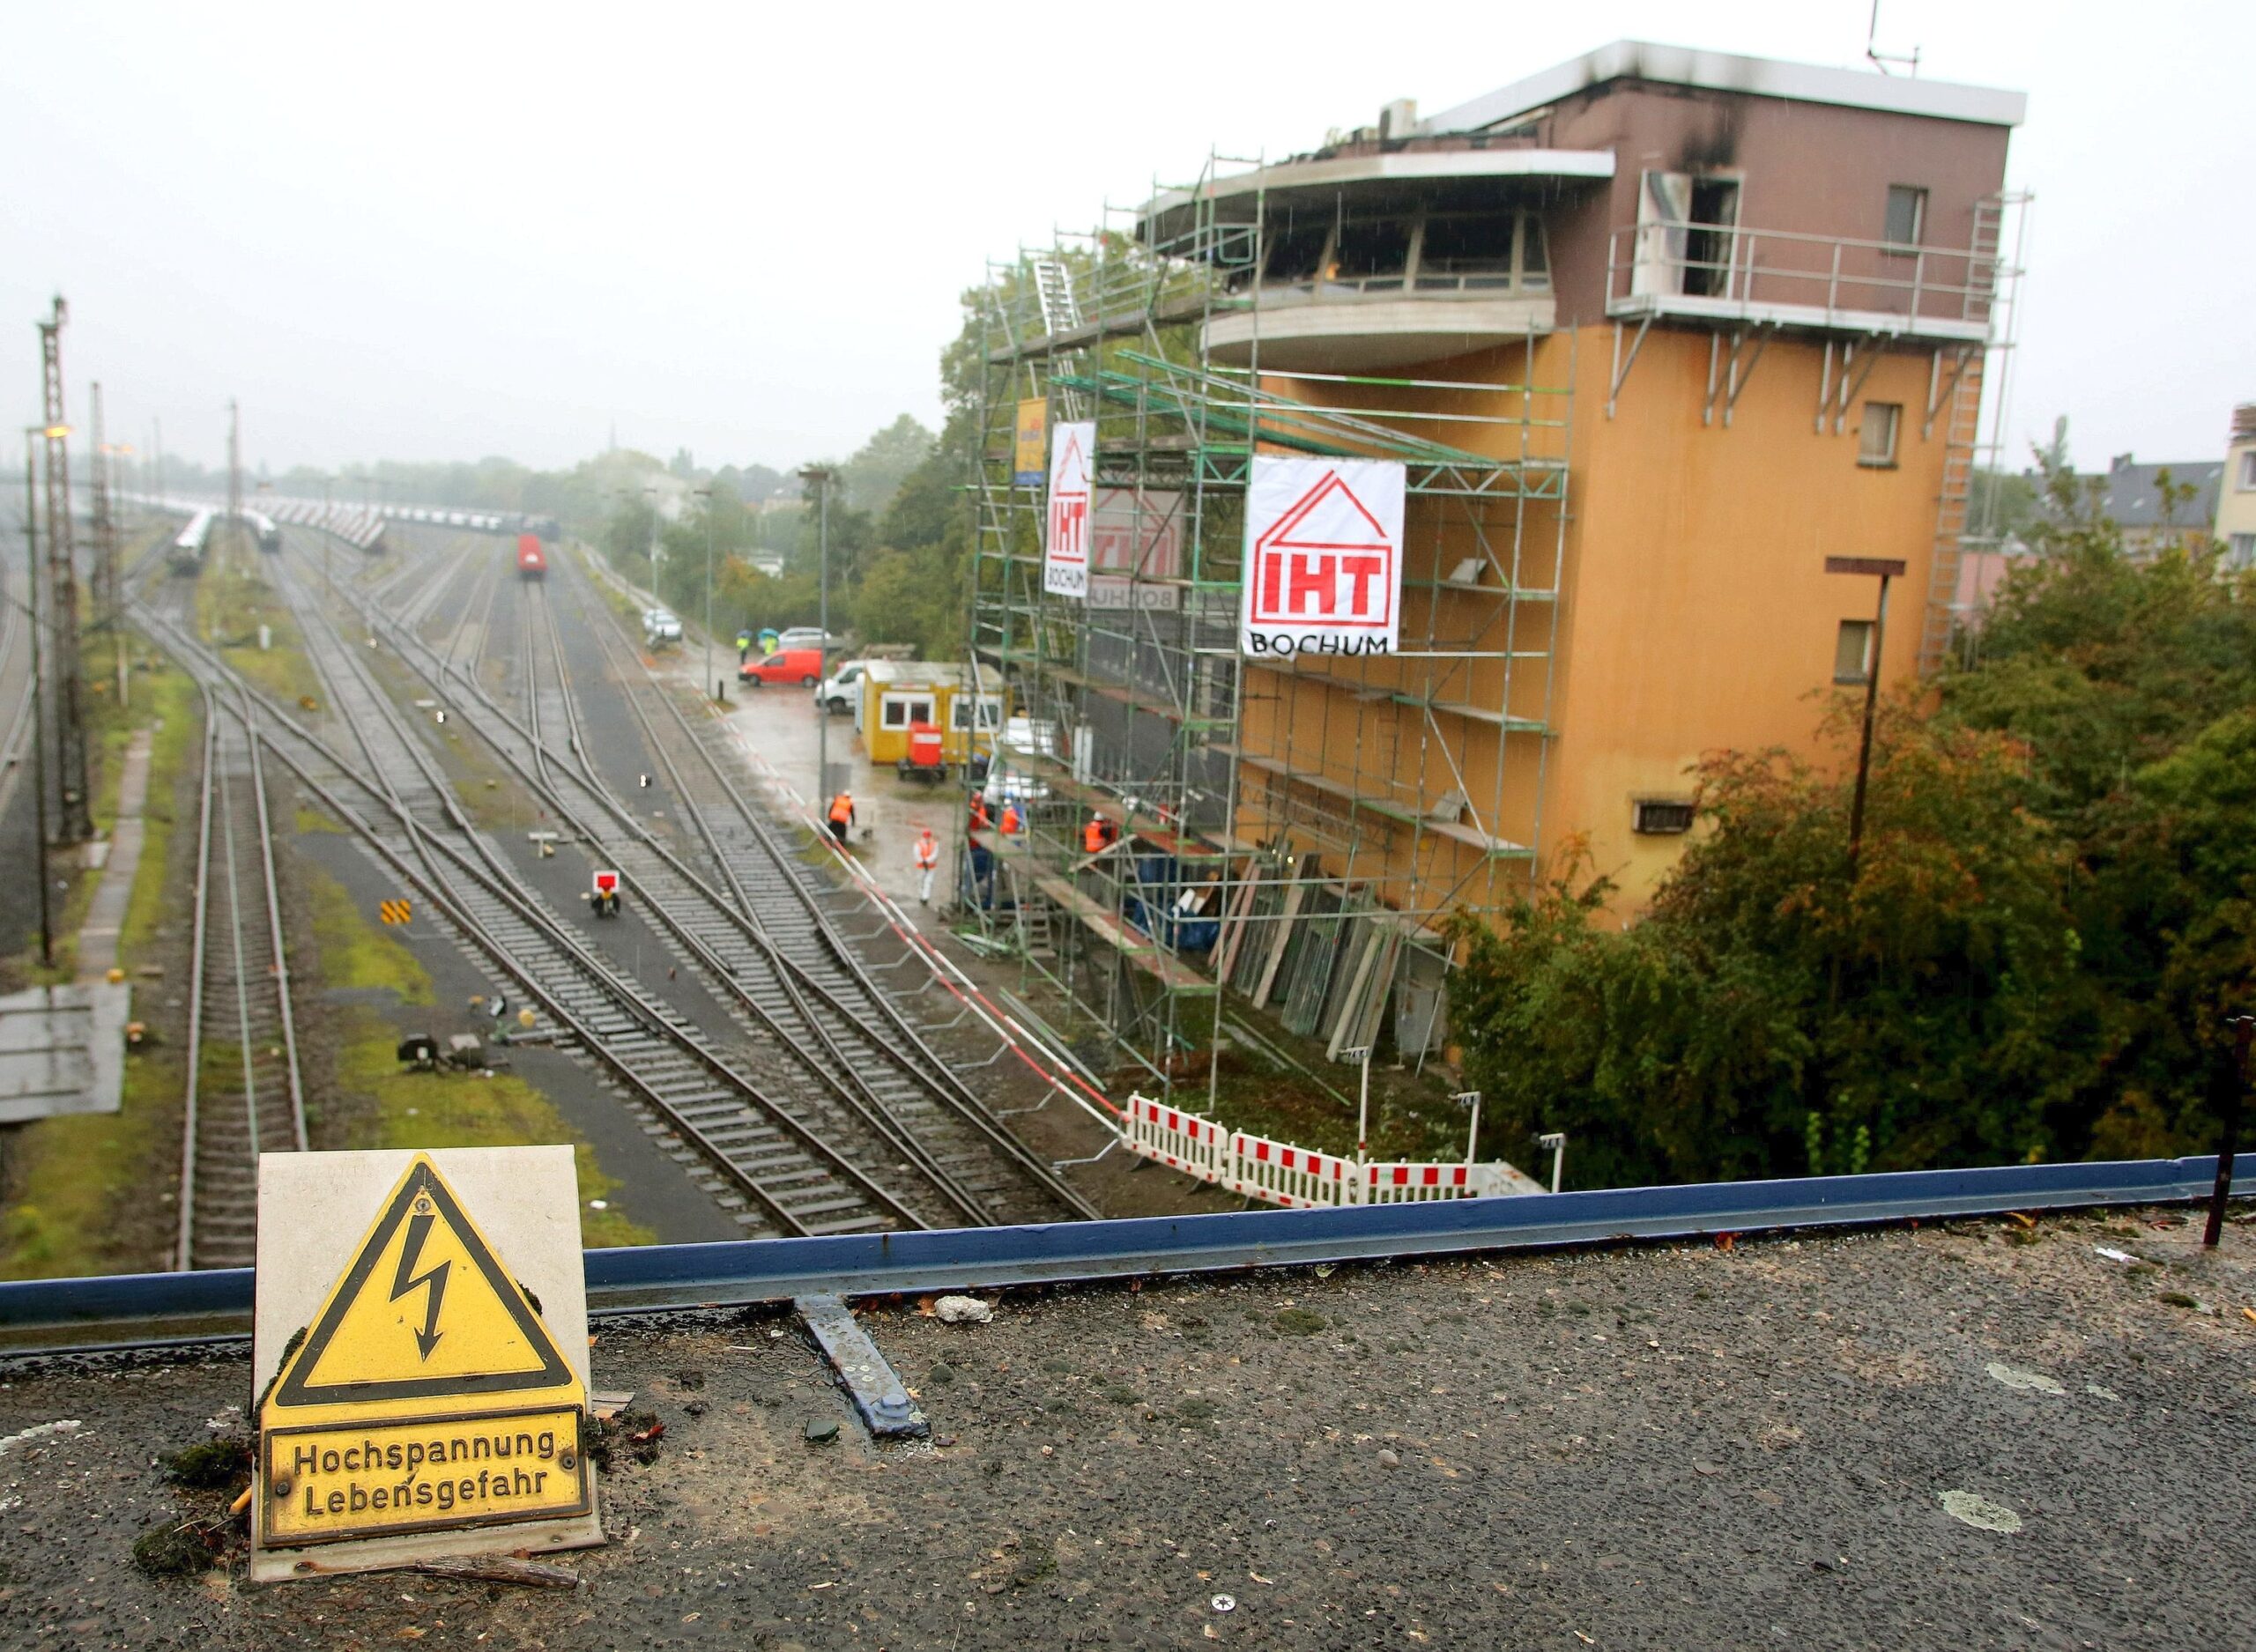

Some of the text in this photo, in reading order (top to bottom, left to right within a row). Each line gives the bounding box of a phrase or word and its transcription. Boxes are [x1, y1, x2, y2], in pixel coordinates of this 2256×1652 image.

[1051, 502, 1086, 552] IHT
[1263, 553, 1381, 615] IHT
[1250, 632, 1388, 656] BOCHUM
[294, 1431, 554, 1475] Hochspannung
[305, 1467, 548, 1515] Lebensgefahr
